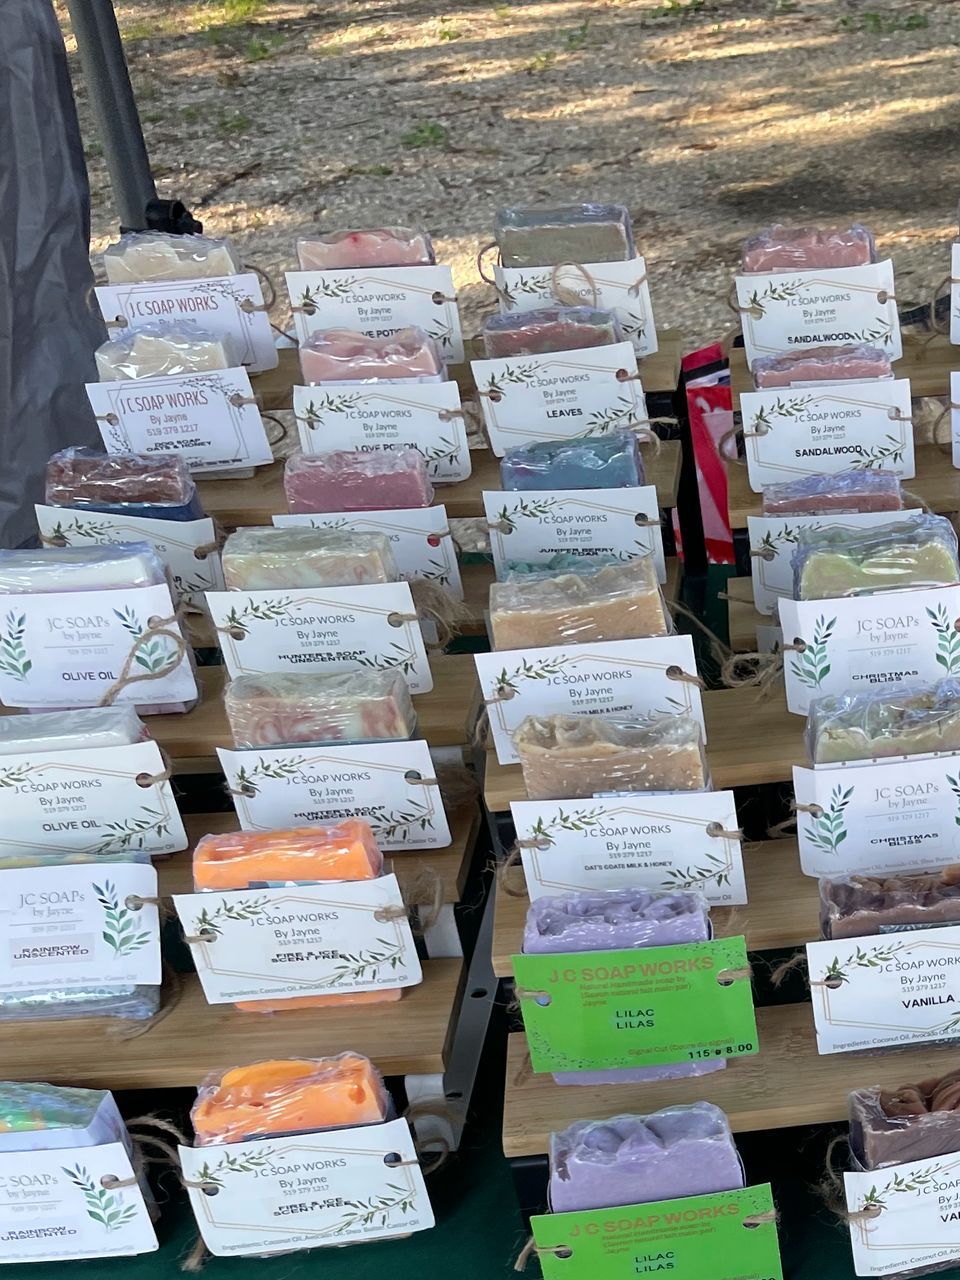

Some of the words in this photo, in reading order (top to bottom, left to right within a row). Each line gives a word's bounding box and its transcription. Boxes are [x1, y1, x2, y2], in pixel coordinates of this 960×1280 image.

[788, 333, 850, 344] SANDALWOOD
[547, 408, 583, 418] LEAVES
[795, 445, 862, 457] SANDALWOOD
[290, 616, 315, 626] SOAP
[318, 614, 355, 624] WORKS
[62, 672, 96, 681] OLIVE
[98, 671, 117, 680] OIL
[563, 674, 590, 684] SOAP
[593, 670, 632, 681] WORKS
[852, 670, 919, 680] CHRISTMAS
[301, 774, 329, 784] SOAP
[332, 772, 371, 782] WORKS
[31, 782, 59, 793] SOAP
[61, 779, 102, 789] WORKS
[42, 821, 79, 832] OLIVE
[81, 820, 101, 829] OIL
[871, 833, 939, 844] CHRISTMAS
[13, 949, 89, 959] UNSCENTED
[581, 965, 636, 982] SOAP
[639, 957, 714, 977] WORKS
[900, 976, 915, 985] By
[917, 973, 946, 984] Jayne
[930, 982, 946, 990] 1217
[902, 994, 955, 1009] VANILLA
[616, 1009, 654, 1018] LILAC
[616, 1020, 654, 1029] LILAS
[872, 1035, 899, 1044] Coconut
[688, 1050, 710, 1059] 115
[279, 1179, 294, 1189] By
[296, 1176, 327, 1187] Jayne
[938, 1195, 952, 1205] By
[603, 1215, 660, 1233] SOAP
[663, 1203, 740, 1224] WORKS
[1, 1230, 77, 1241] UNSCENTED
[8, 1226, 67, 1235] RAINBOW
[635, 1251, 675, 1263] LILAC
[636, 1262, 675, 1273] LILAS
